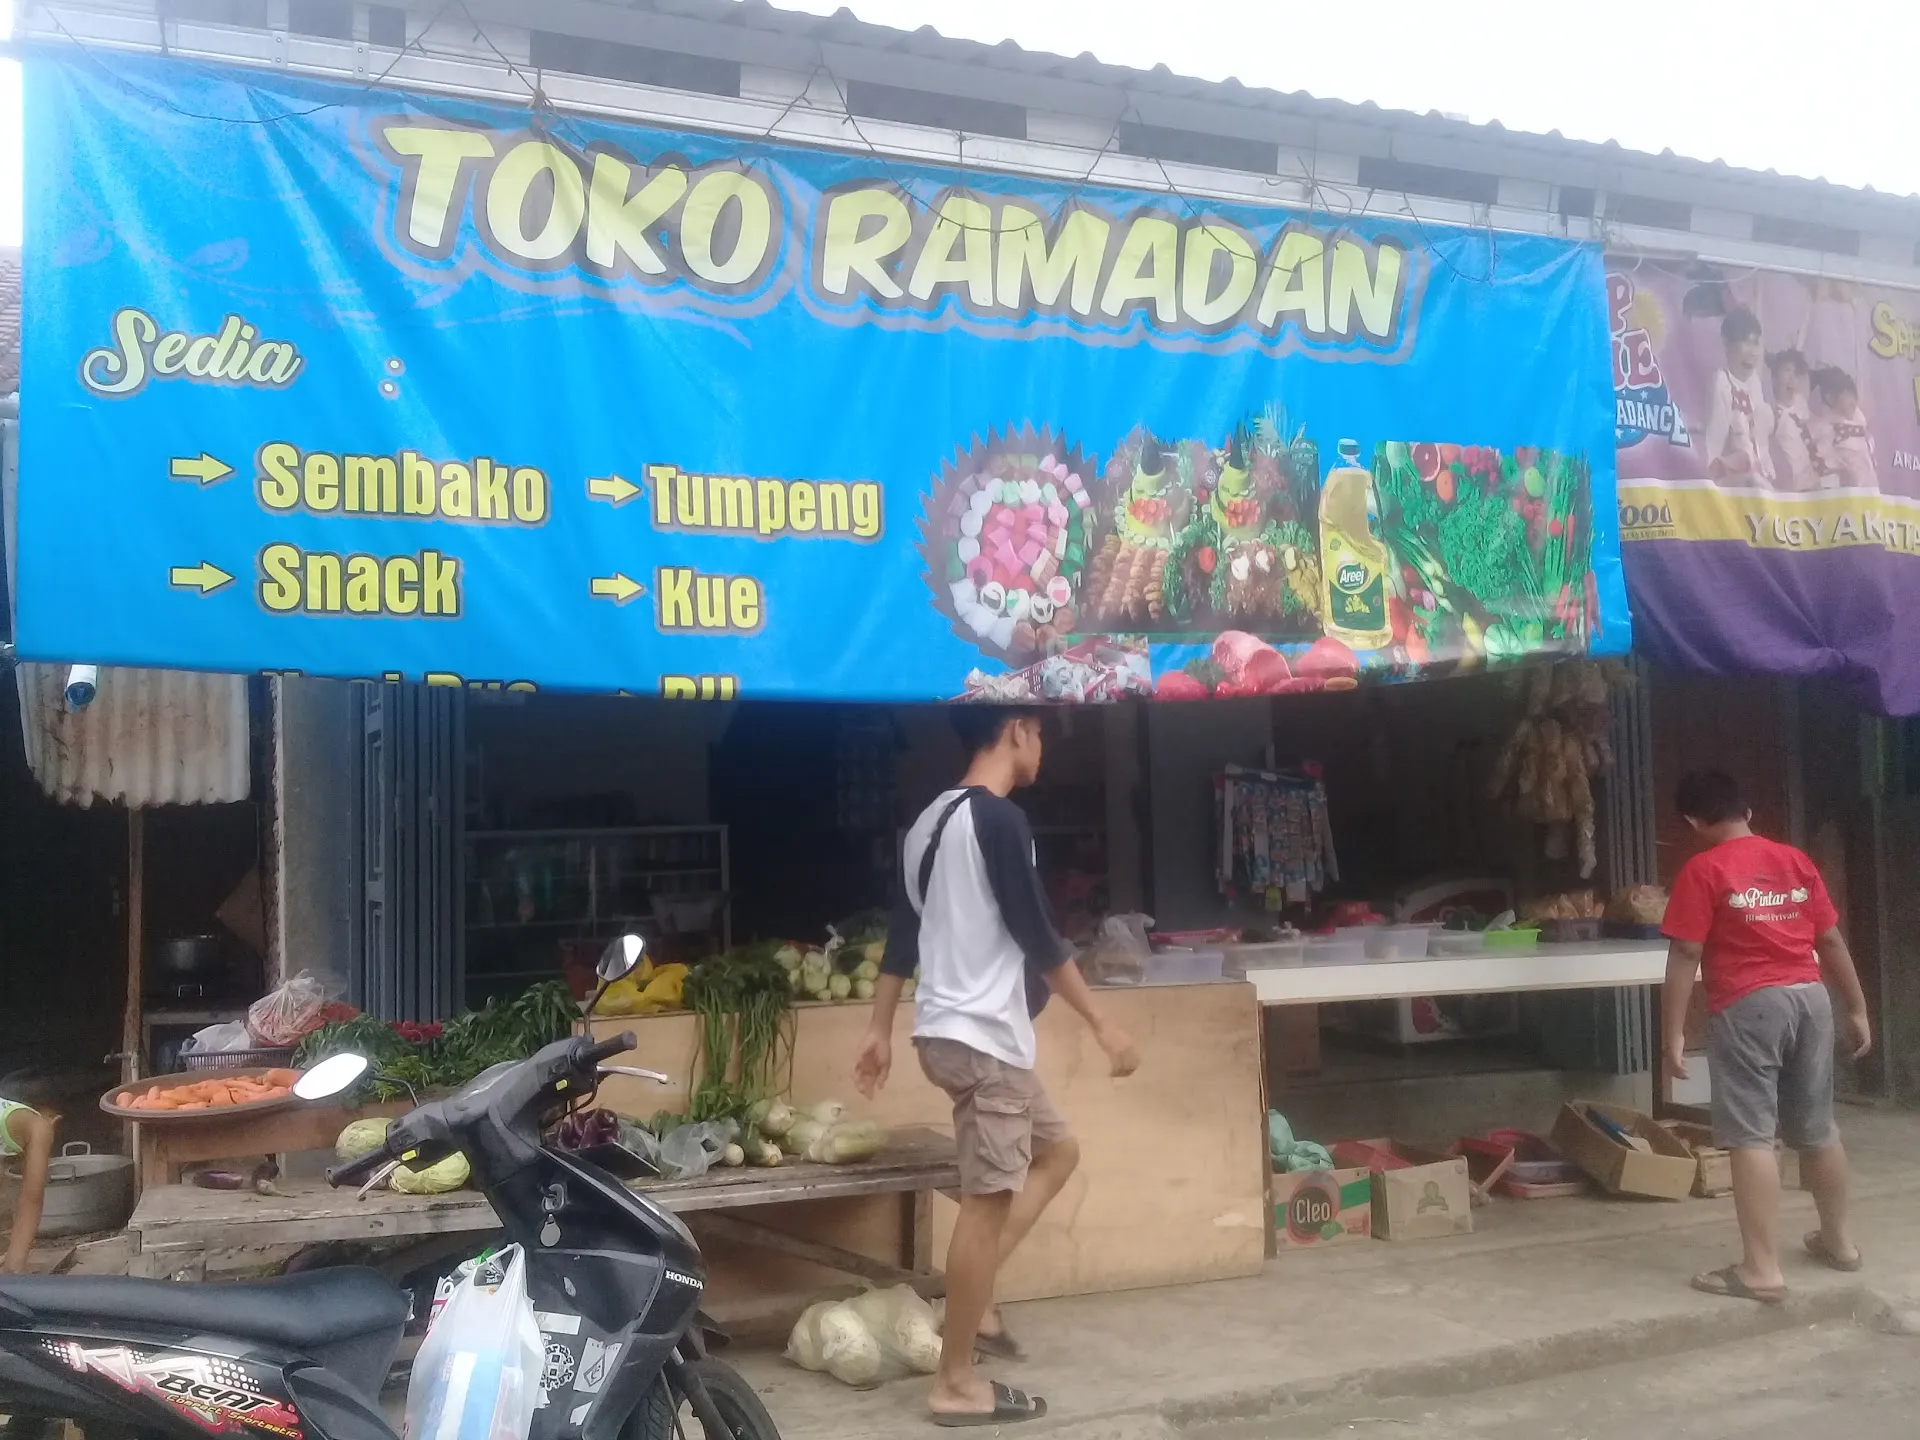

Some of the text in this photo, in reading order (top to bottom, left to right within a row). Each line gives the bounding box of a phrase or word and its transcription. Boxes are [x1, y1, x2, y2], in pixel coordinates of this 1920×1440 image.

[381, 126, 1401, 338] TOKO RAMADAN
[83, 308, 300, 393] Sedia
[259, 442, 545, 522] Sembako
[649, 465, 880, 537] Tumpeng
[1618, 498, 1673, 527] ood
[261, 545, 459, 615] Snack
[660, 567, 759, 628] Kue
[1745, 887, 1788, 908] Pintar
[1295, 1199, 1332, 1224] Cleo
[665, 1270, 704, 1290] HONDA
[166, 1394, 298, 1439] Compact Sportmatic
